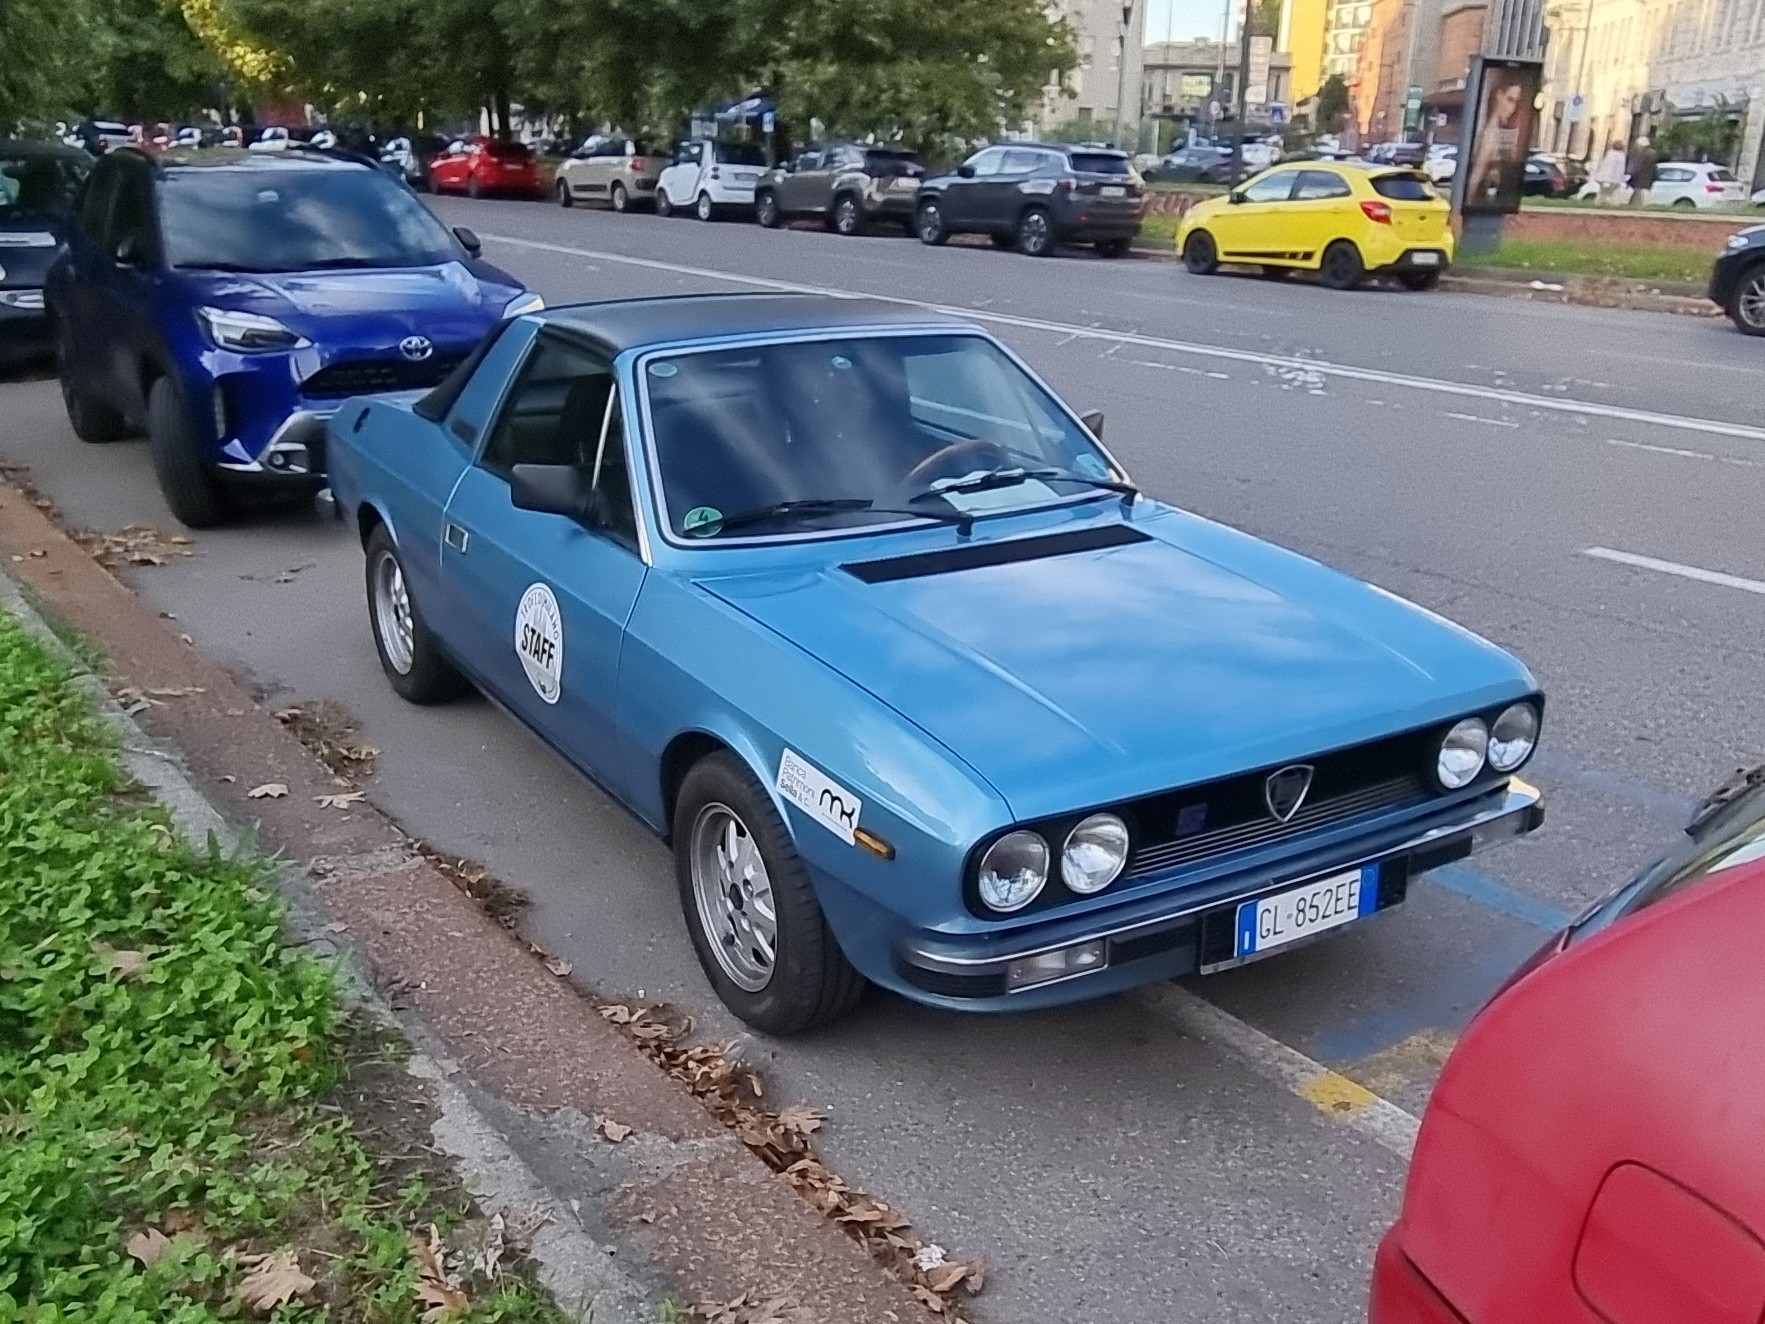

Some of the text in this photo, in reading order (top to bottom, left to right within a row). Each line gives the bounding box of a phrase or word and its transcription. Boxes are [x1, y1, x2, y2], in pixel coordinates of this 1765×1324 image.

[521, 622, 556, 669] STAFF
[785, 755, 807, 779] Banca
[780, 778, 798, 798] Sella
